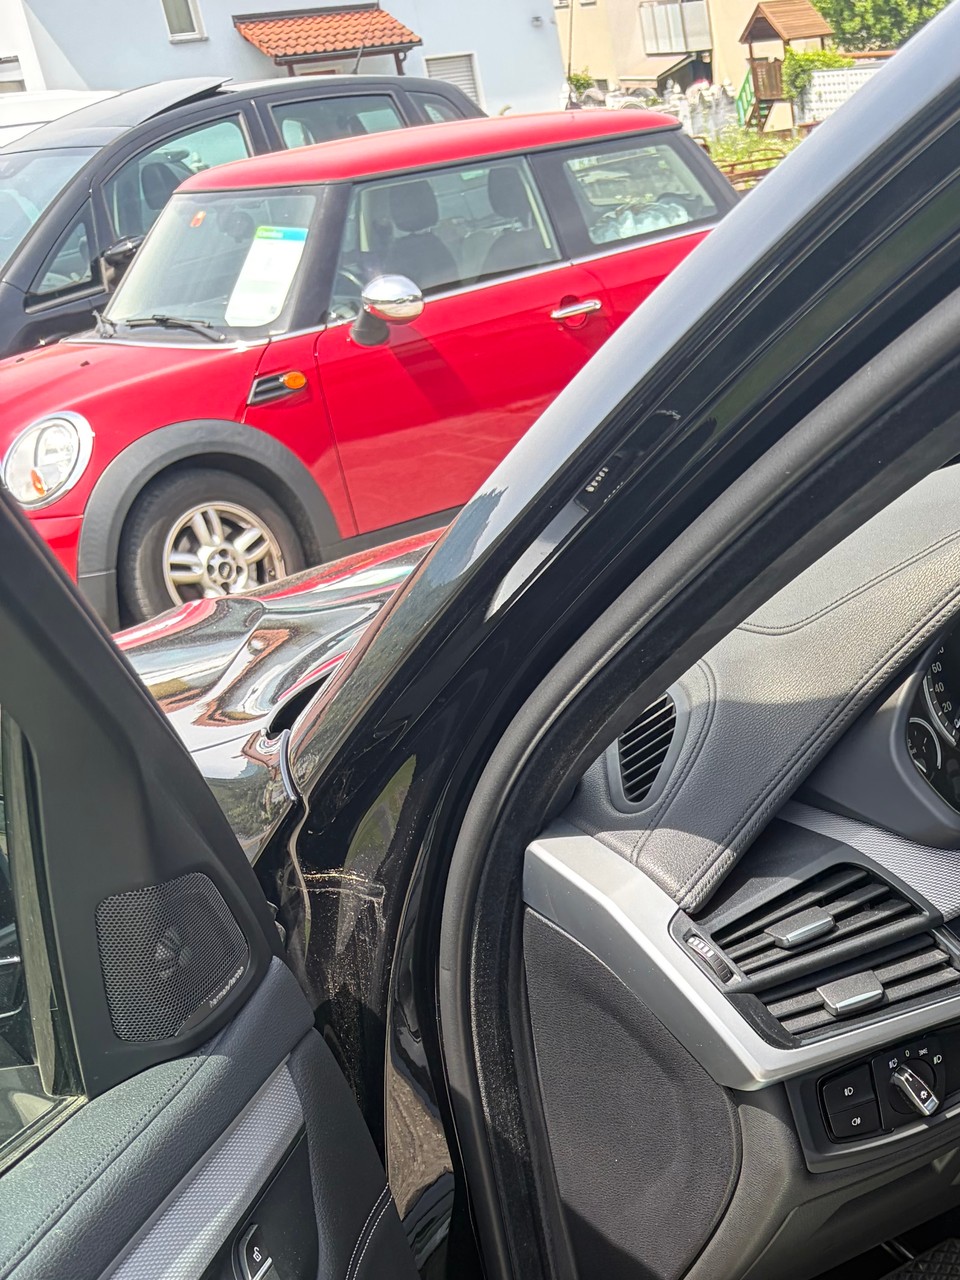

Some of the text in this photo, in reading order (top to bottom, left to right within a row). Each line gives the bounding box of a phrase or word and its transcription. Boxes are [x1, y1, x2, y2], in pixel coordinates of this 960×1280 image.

[931, 661, 942, 674] 60
[934, 682, 944, 693] 40
[941, 701, 953, 713] 20
